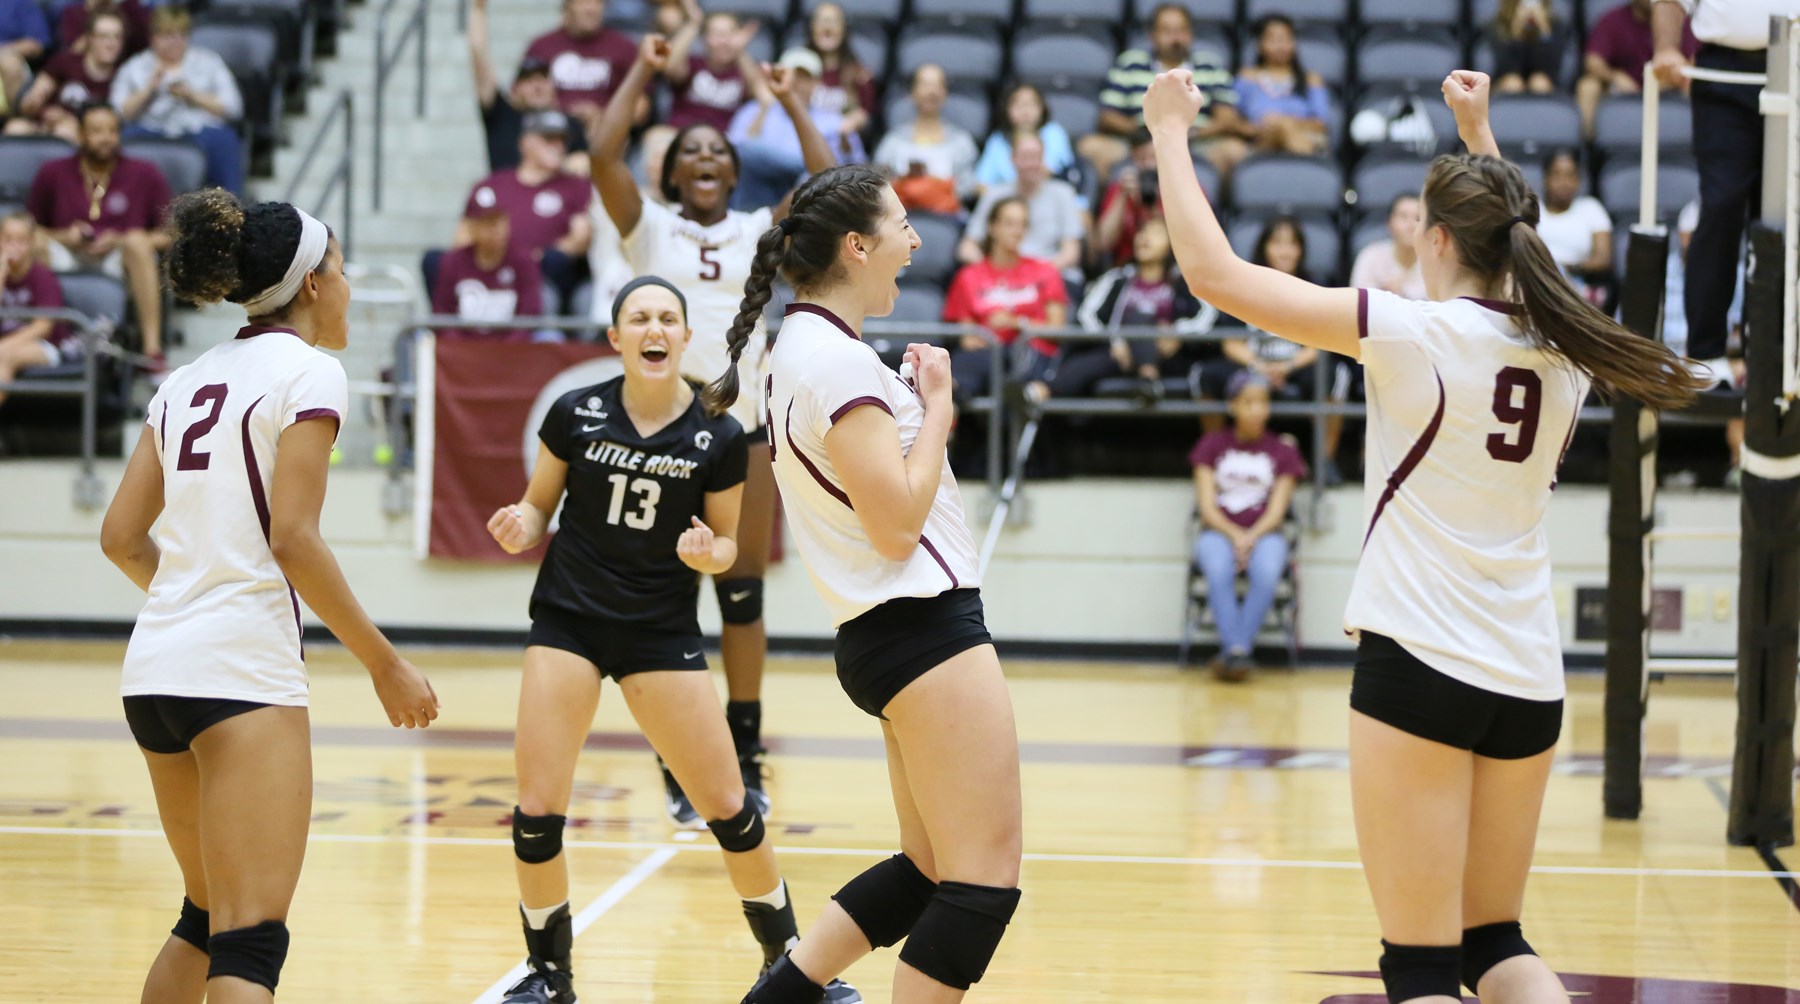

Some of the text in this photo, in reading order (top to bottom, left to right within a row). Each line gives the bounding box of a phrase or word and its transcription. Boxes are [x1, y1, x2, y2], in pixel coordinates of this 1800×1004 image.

[699, 246, 721, 281] 5
[177, 383, 228, 470] 2
[1486, 366, 1542, 463] 9
[584, 440, 698, 479] LITTLE ROCK
[606, 473, 662, 531] 13
